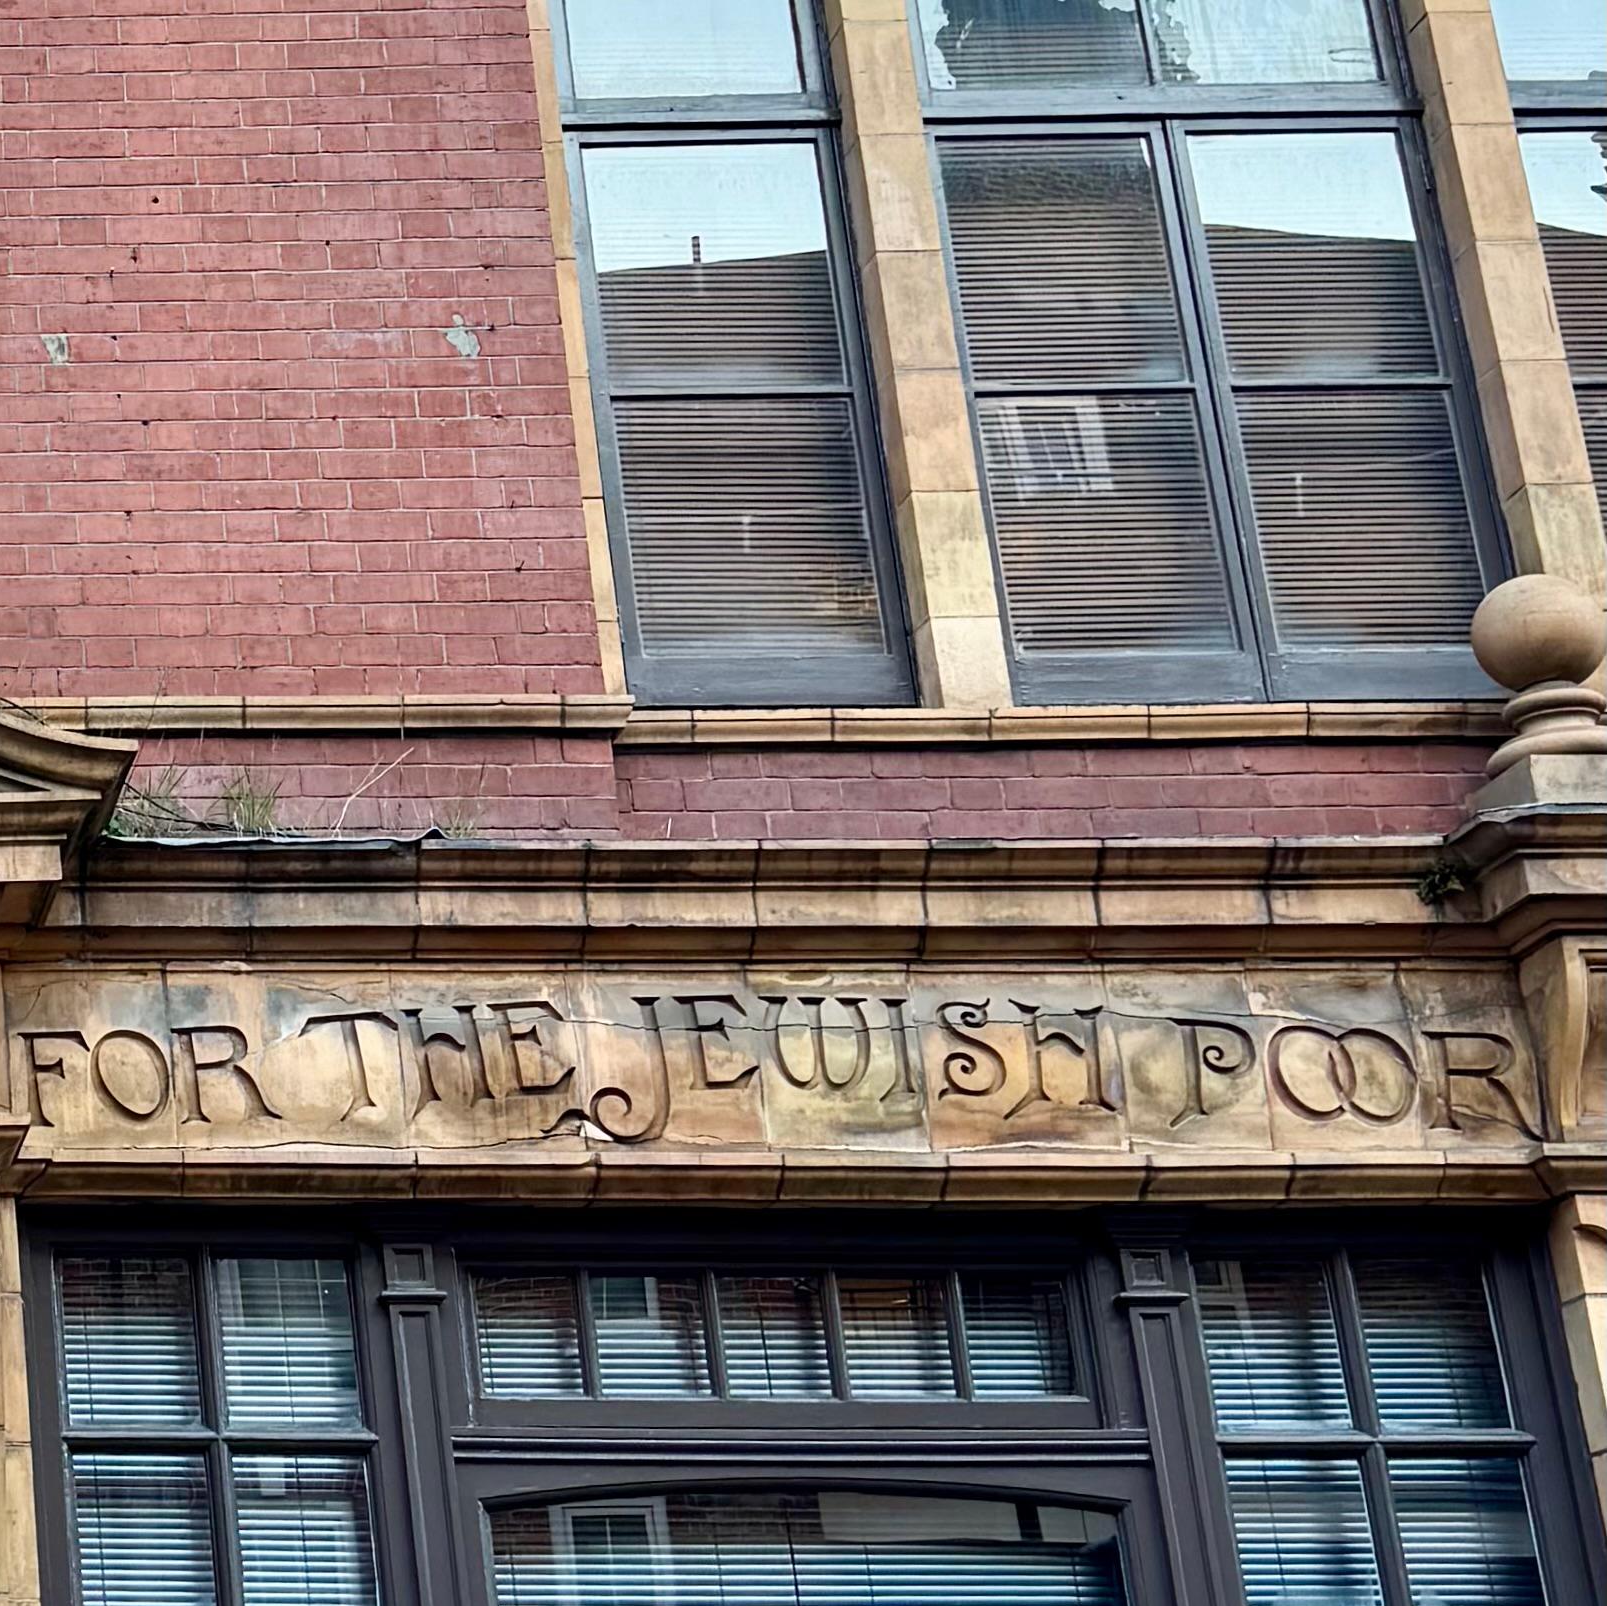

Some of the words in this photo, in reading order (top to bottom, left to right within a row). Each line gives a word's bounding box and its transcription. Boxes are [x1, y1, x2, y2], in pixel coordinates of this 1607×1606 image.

[17, 1025, 283, 1128] FOR
[297, 1000, 578, 1122] THE
[539, 994, 1123, 1145] JEWISH
[1160, 1016, 1545, 1142] POOR
